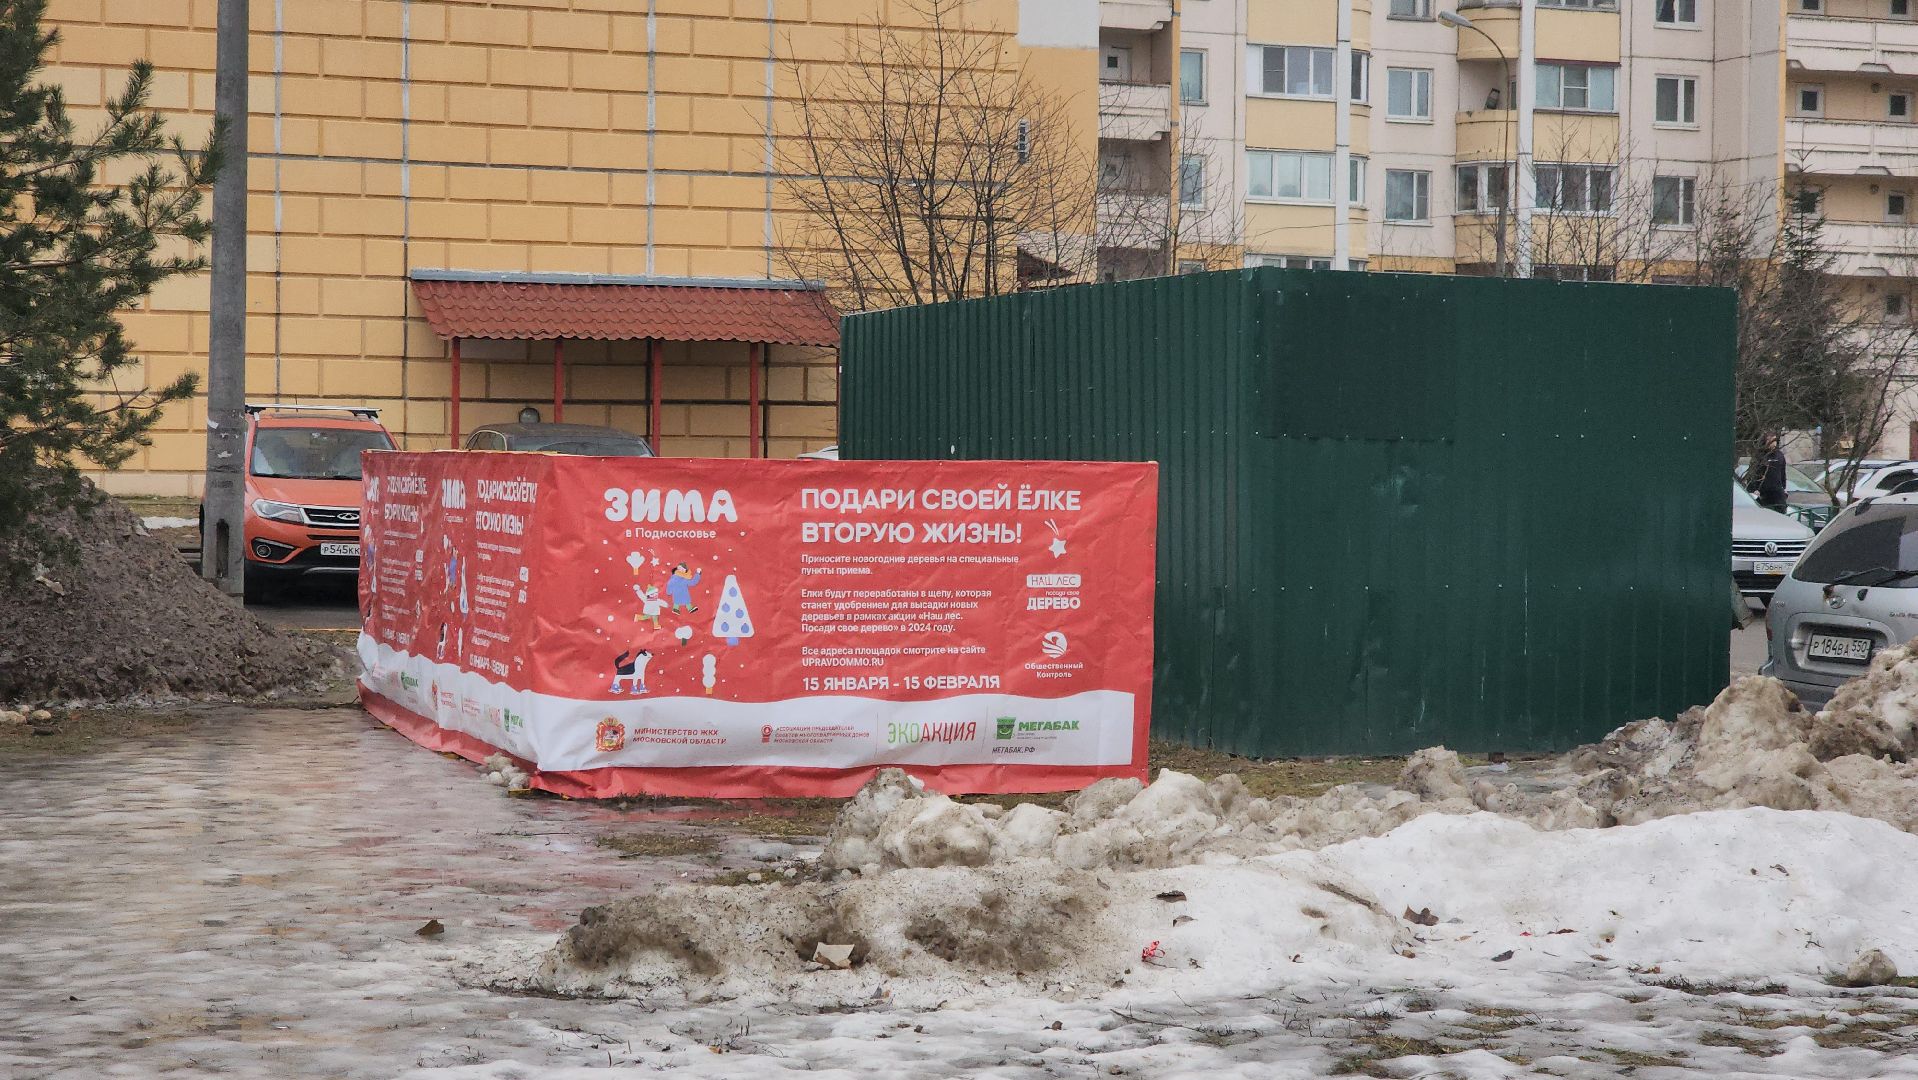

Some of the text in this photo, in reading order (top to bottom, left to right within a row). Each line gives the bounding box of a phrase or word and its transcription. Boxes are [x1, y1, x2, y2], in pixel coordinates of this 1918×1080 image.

[801, 483, 1081, 514] ПОДАРИ СВОЕЙ ЁЛКЕ
[603, 487, 739, 523] ЗИМА
[625, 527, 717, 540] в Подмосковье
[801, 522, 1022, 544] ВТОРУЮ ЖИЗНЬ!
[801, 554, 851, 564] Приносите
[852, 555, 905, 564] новогодние
[907, 555, 946, 564] деревья
[958, 555, 1019, 564] специальные
[801, 567, 873, 576] пункты приема.
[1031, 576, 1077, 586] НАШ ЛЕС
[801, 588, 823, 598] Елки
[824, 588, 852, 599] будут
[853, 588, 919, 599] переработаны
[927, 590, 954, 599] щепу,
[955, 590, 992, 598] которая
[833, 600, 890, 610] удобрением
[891, 602, 908, 610] для
[910, 602, 949, 610] высадки
[1026, 597, 1081, 611] ДЕРЕВО
[801, 613, 845, 622] деревьев
[853, 613, 886, 622] рамках
[888, 613, 916, 621] акции
[801, 623, 836, 633] Посади
[837, 624, 859, 632] свое
[860, 624, 899, 633] дерево»
[908, 623, 931, 632] 2024
[933, 624, 956, 633] году.
[801, 646, 986, 657] Все адреса площадок смотрите на сайте
[801, 657, 885, 667] UPRAVDOMMO.RU
[1024, 662, 1084, 671] Общественный
[1036, 671, 1073, 680] Контроль
[802, 677, 819, 691] 15
[823, 676, 890, 691] ЯНВАРЯ
[903, 676, 920, 690] 15
[923, 675, 1001, 690] ФЕВРАЛЯ
[1018, 720, 1080, 731] МЕГАБАК
[634, 727, 698, 736] МИНИСТЕРСТВО
[887, 720, 977, 745] ЭКОАКЦИЯ
[632, 736, 688, 744] МОСКОВСКОЙ
